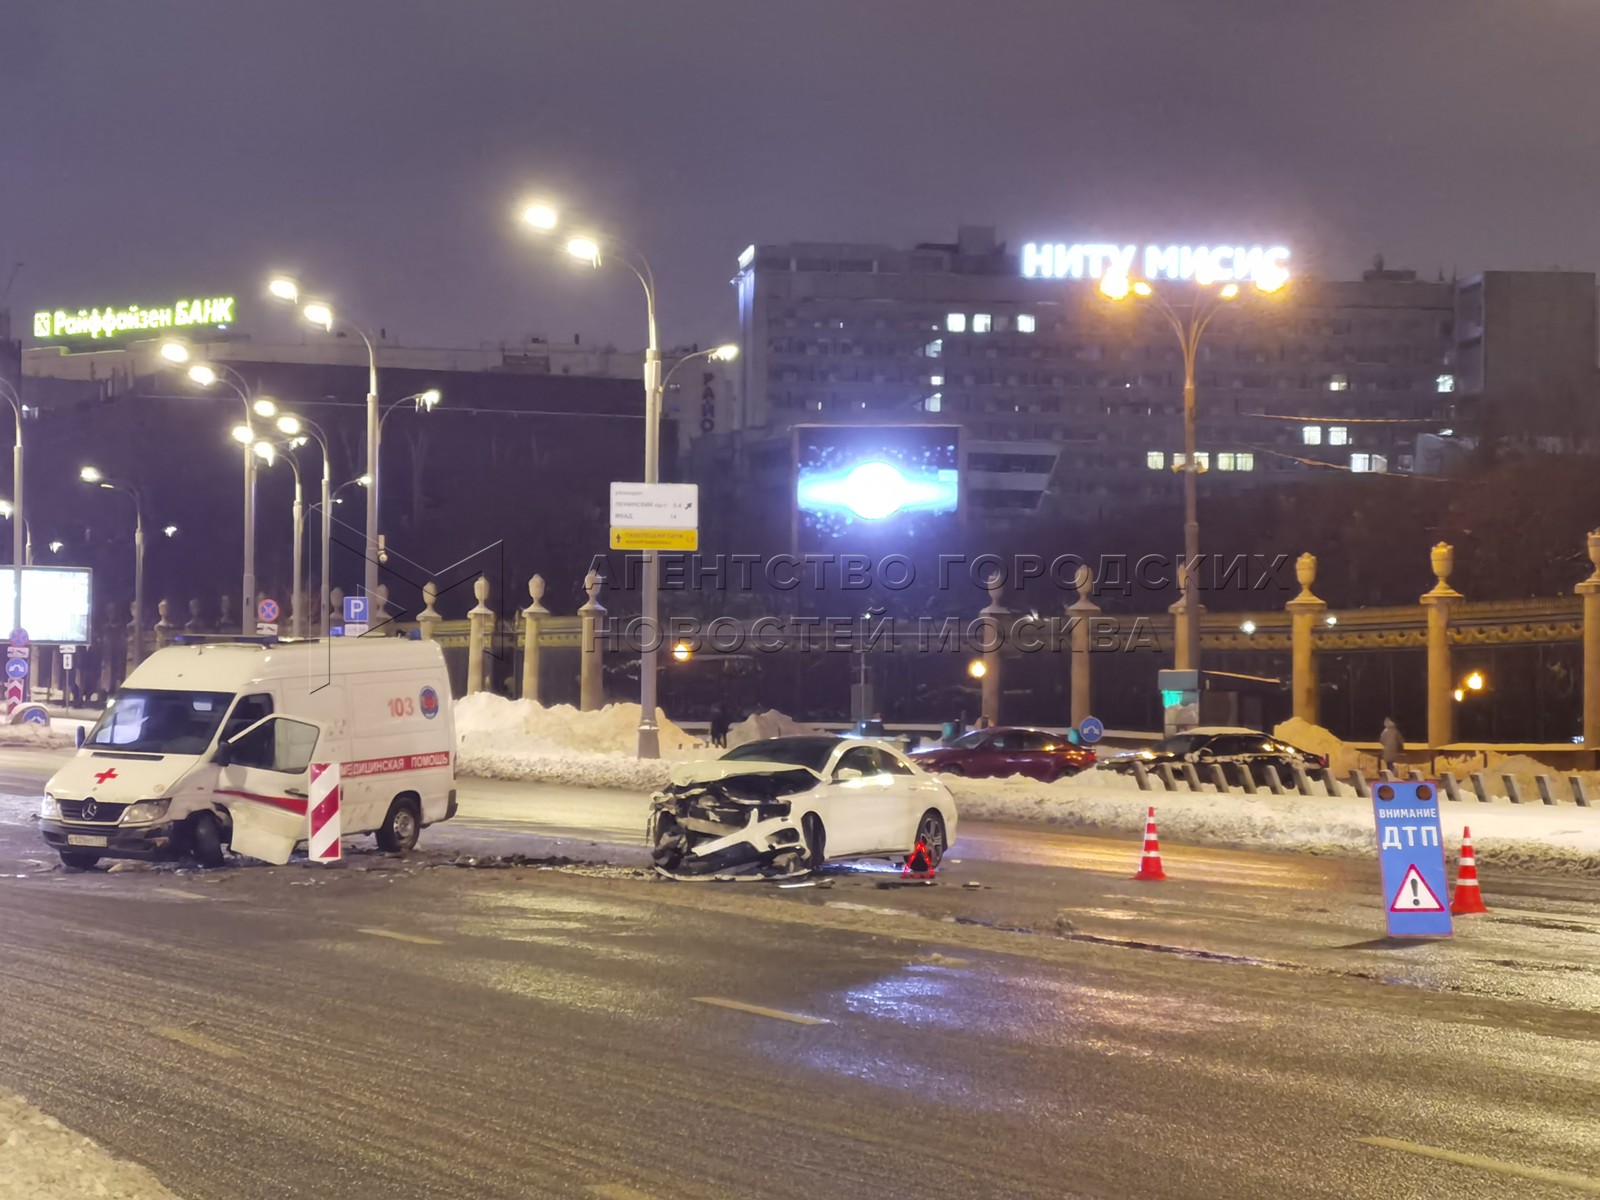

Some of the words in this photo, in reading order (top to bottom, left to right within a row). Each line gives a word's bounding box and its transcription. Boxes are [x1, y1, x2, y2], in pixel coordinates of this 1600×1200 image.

[1023, 243, 1137, 279] НИТУ
[1144, 245, 1291, 281] МИСИС
[53, 304, 172, 339] Райффайзен
[174, 297, 235, 326] БАНК
[387, 697, 415, 717] 103
[410, 754, 448, 767] ПОМОЩЬ
[1378, 808, 1437, 819] ВНИМАНИЕ
[1382, 826, 1439, 850] ДТП
